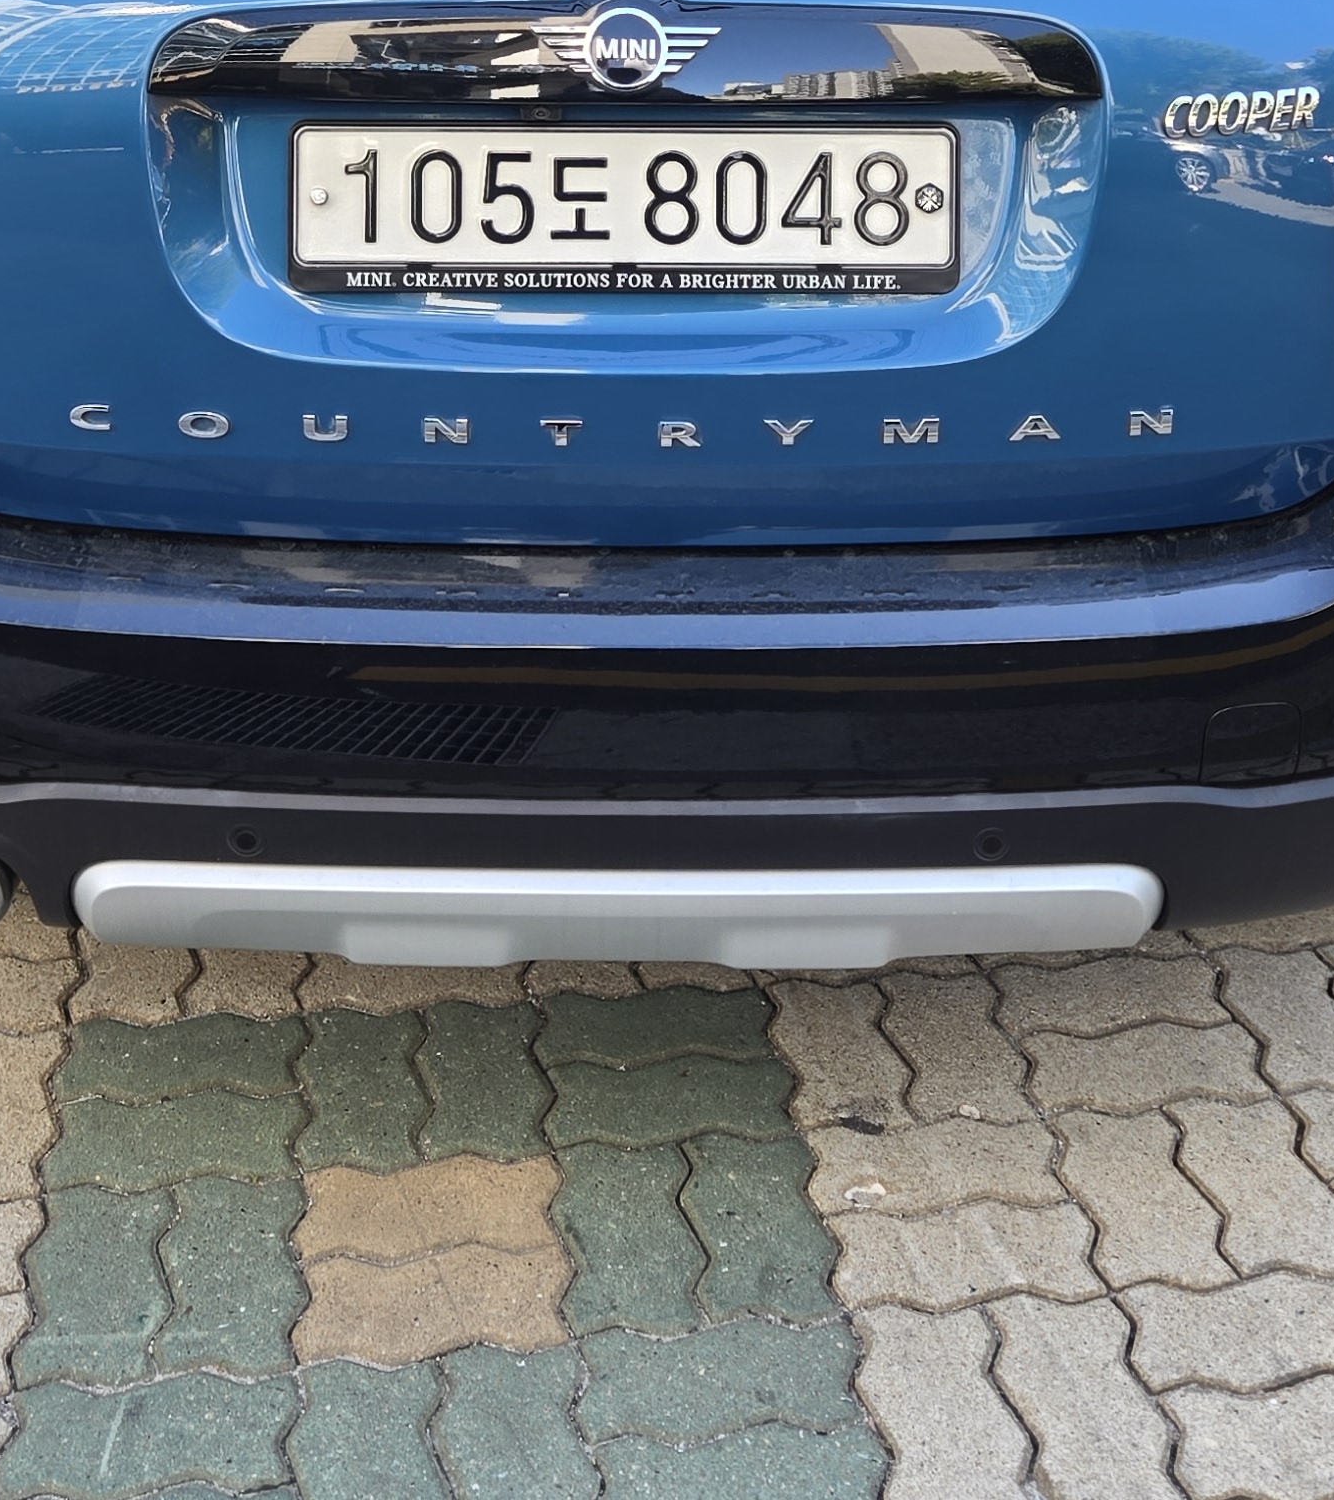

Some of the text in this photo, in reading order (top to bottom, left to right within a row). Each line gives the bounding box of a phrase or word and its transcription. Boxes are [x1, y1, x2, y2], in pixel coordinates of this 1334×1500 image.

[595, 36, 657, 60] MINI
[1164, 85, 1320, 138] COOPER
[644, 150, 910, 246] 8048
[403, 272, 498, 288] CREATIVE
[503, 273, 610, 288] SOLUTIONS
[616, 273, 655, 288] FOR
[659, 273, 674, 288] A
[679, 273, 777, 289] BRIGHTER
[782, 274, 847, 289] URBAN
[68, 403, 1176, 448] COUNTRYMAN
